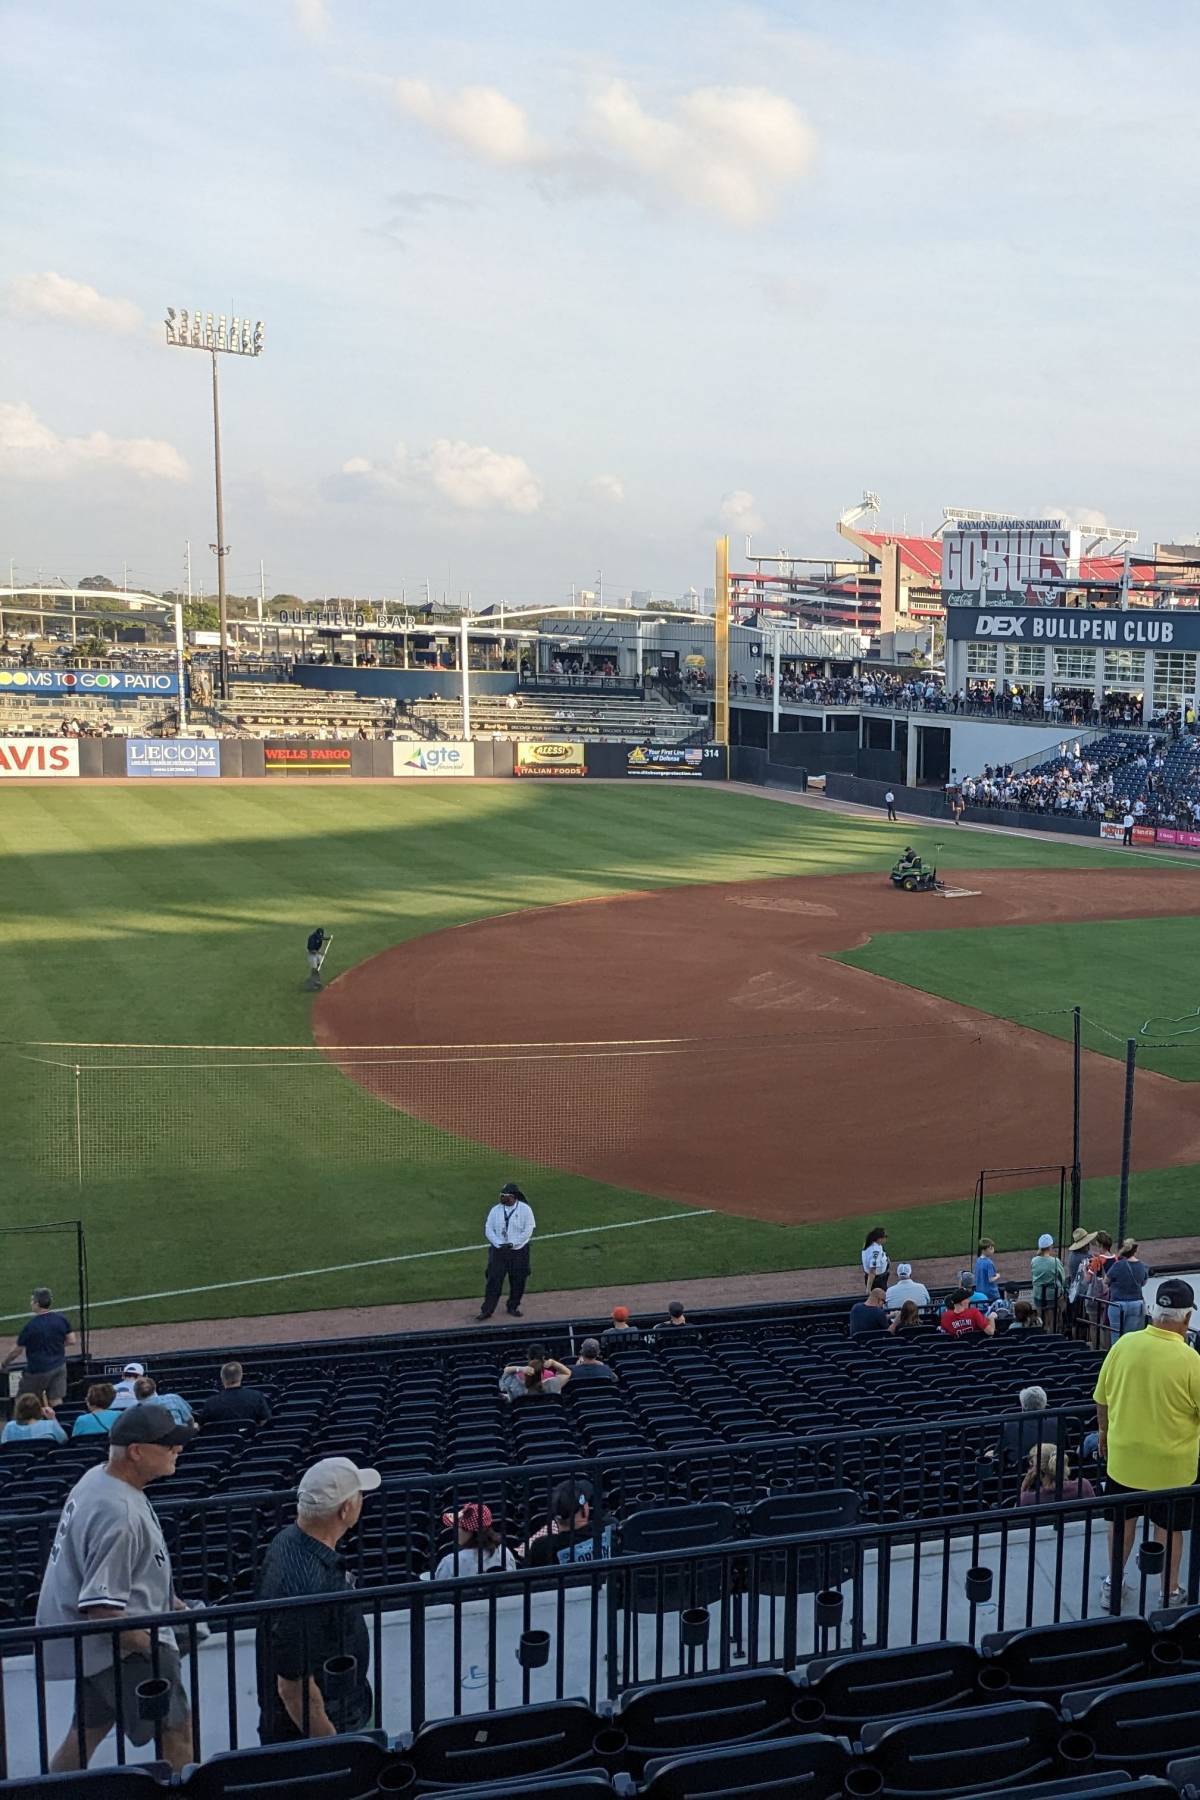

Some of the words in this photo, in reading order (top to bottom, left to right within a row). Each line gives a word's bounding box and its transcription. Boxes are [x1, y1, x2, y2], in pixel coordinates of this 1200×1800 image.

[957, 520, 998, 530] RAYMOND
[998, 520, 1025, 530] JAMES
[1025, 519, 1062, 530] STADIUM
[280, 610, 364, 627] OUTFIELD
[376, 614, 416, 629] BAR
[975, 615, 1027, 636] DEX
[1032, 617, 1117, 640] BULLPEN
[1123, 620, 1174, 643] CLUB
[55, 673, 77, 687] TO
[81, 673, 110, 687] GO
[125, 675, 171, 689] PATIO
[265, 749, 308, 759] WELLS
[311, 749, 351, 759] FARGO
[426, 746, 460, 766] gte
[704, 749, 719, 758] 314
